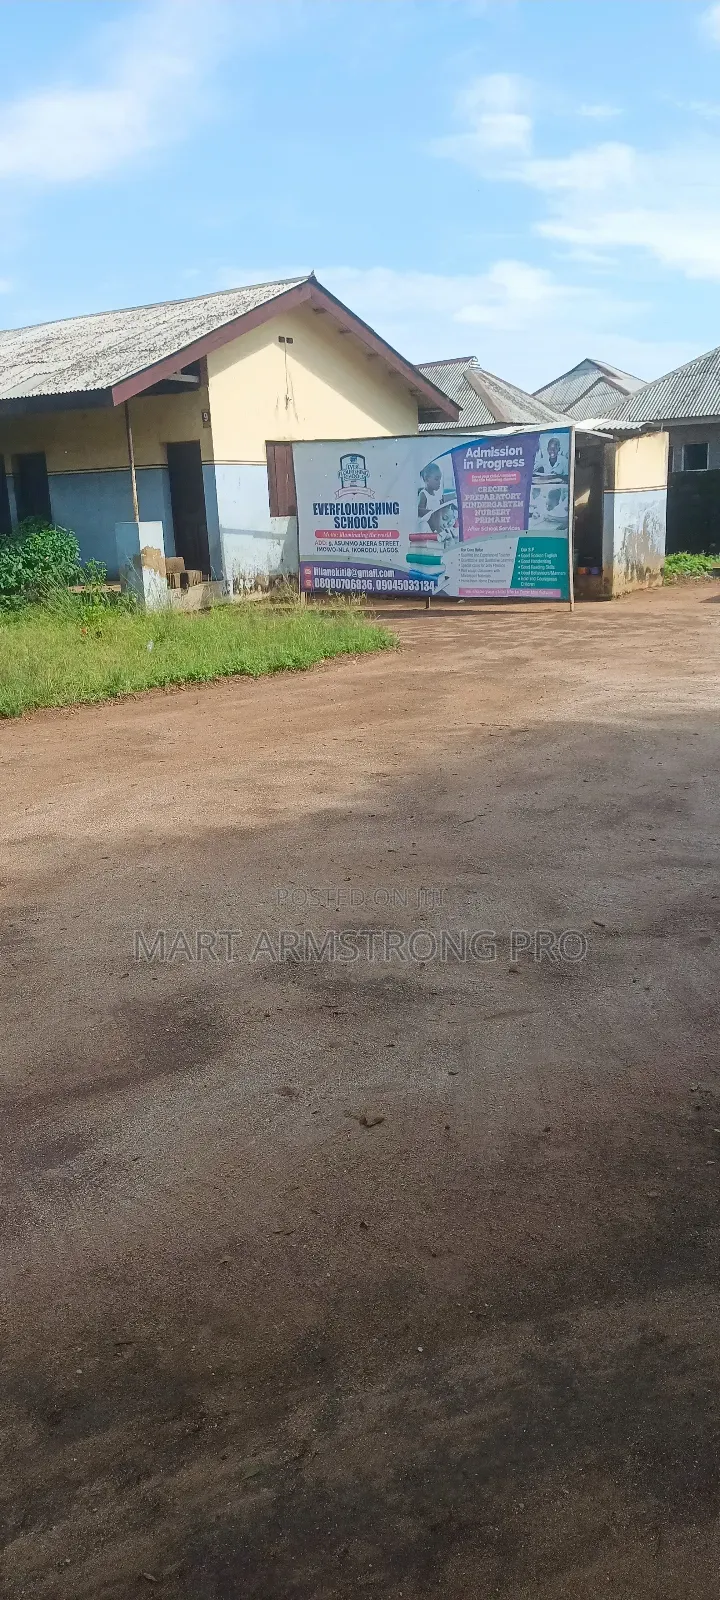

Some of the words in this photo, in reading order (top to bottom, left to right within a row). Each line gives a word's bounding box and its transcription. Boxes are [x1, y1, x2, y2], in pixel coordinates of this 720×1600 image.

[204, 412, 208, 421] 9
[466, 446, 522, 458] Admission
[464, 459, 473, 469] in
[477, 458, 525, 471] Progress
[313, 502, 399, 515] EVERFLOURISHING
[334, 516, 378, 529] SCHOOLS
